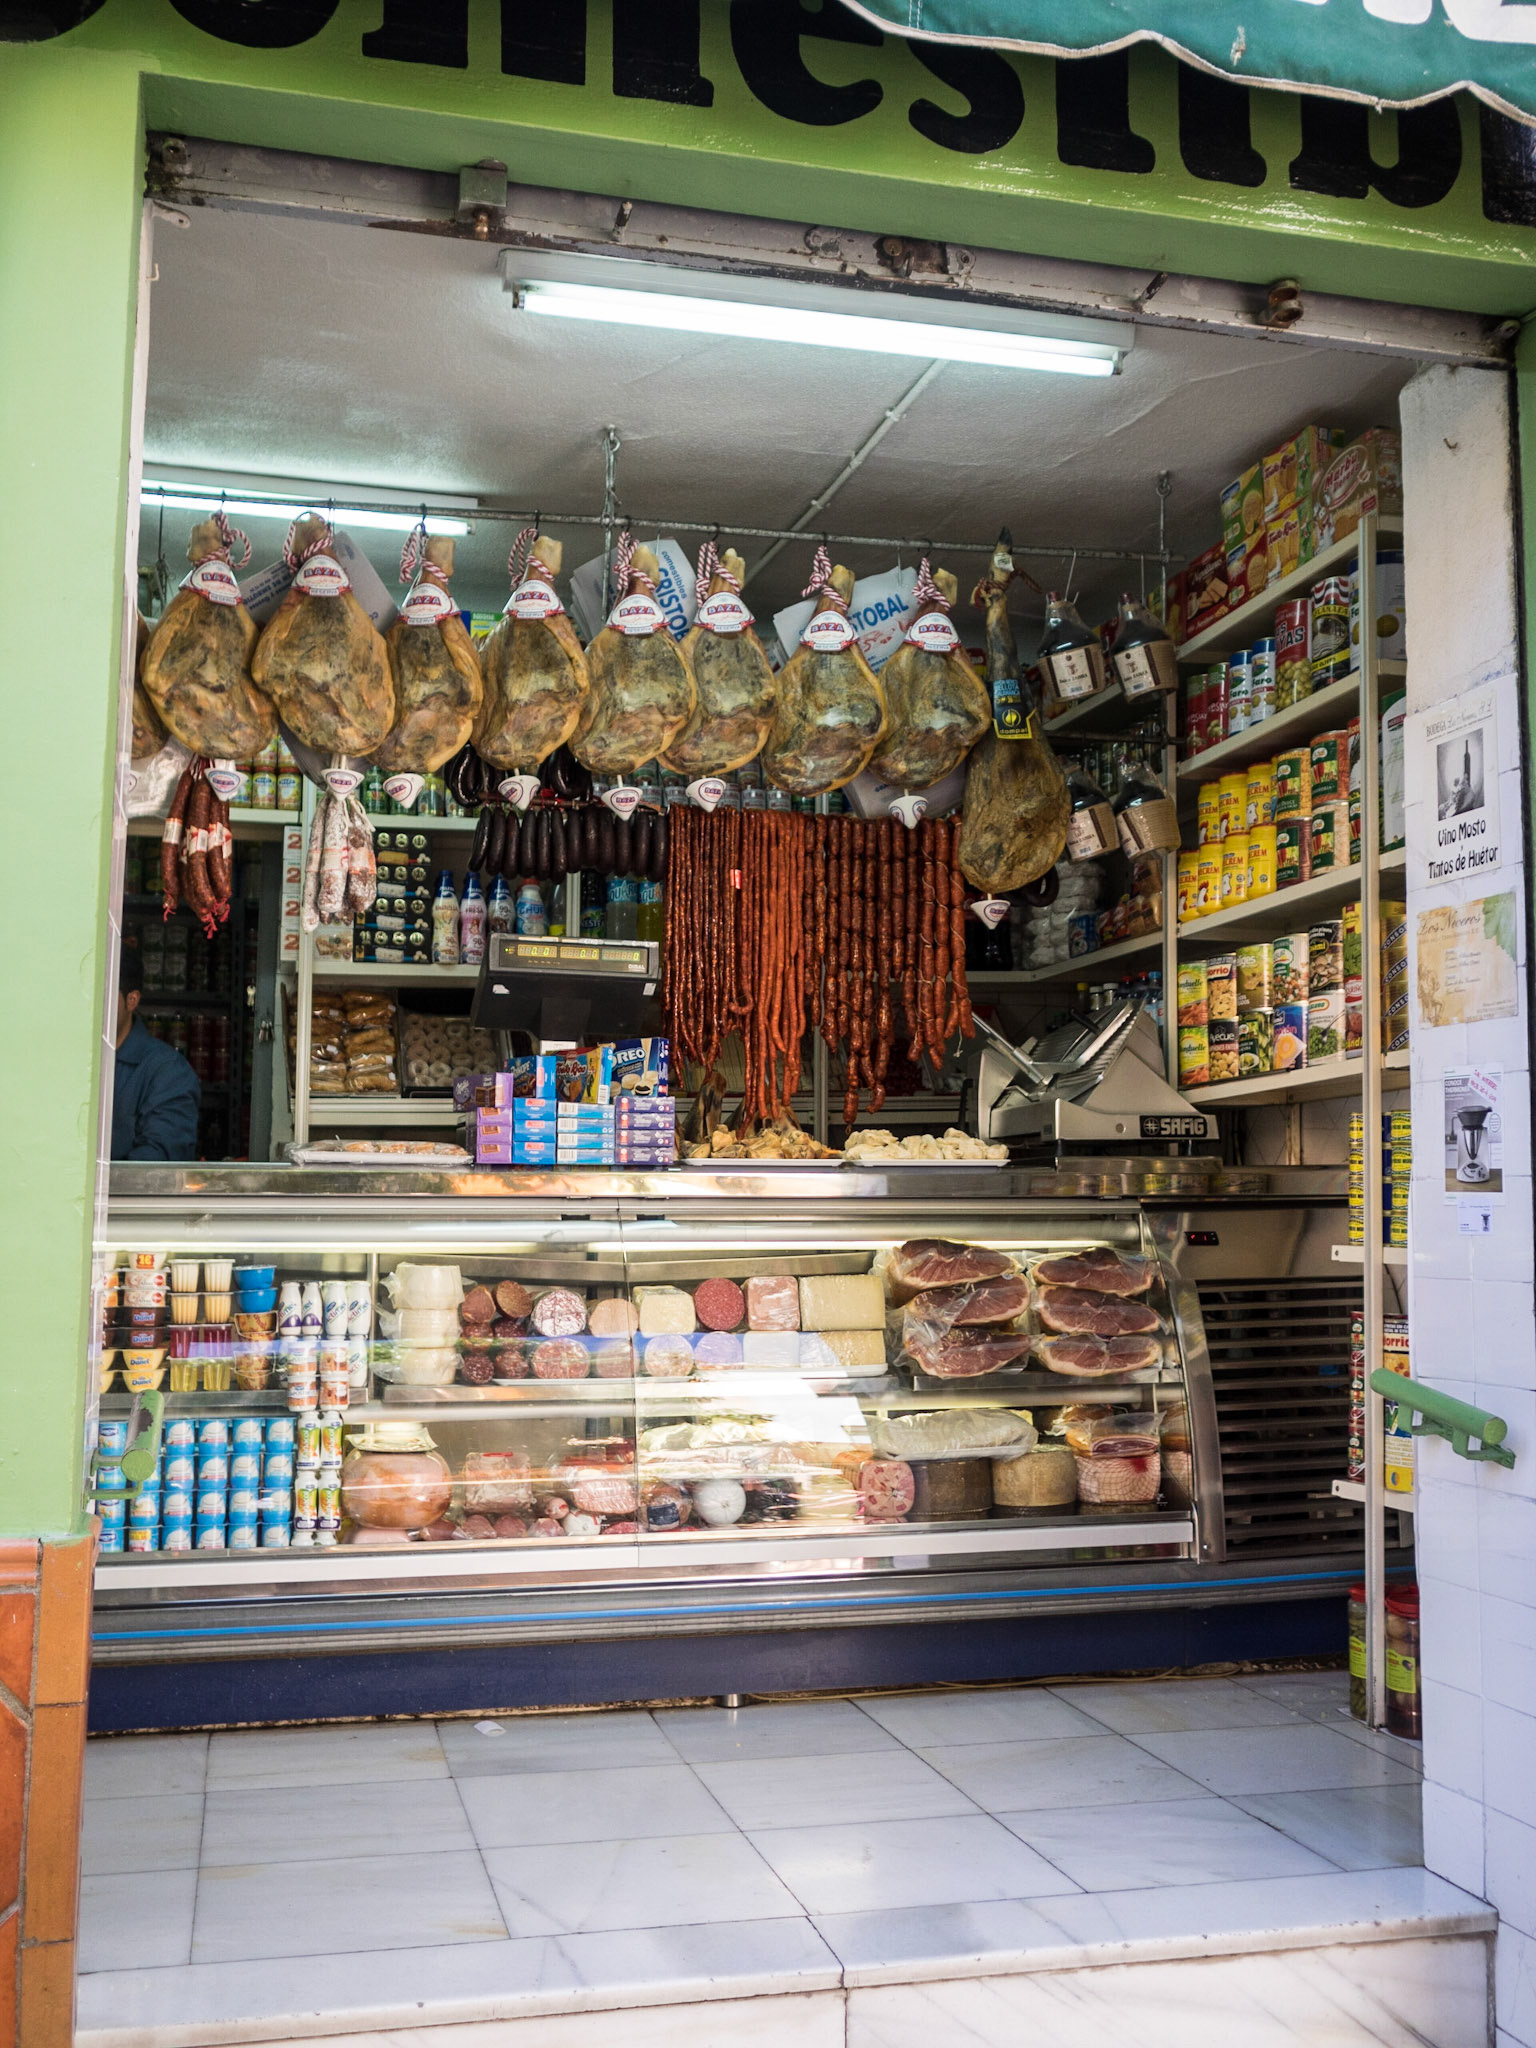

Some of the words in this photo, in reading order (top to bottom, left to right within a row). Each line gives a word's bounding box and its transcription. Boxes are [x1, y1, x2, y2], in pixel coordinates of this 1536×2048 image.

[303, 566, 342, 579] BAZA
[661, 550, 688, 600] comestibles
[406, 595, 441, 607] BAZA
[515, 591, 551, 602] BAZA
[619, 605, 656, 617] BAZA
[707, 603, 743, 615] BAZA
[810, 622, 845, 634] BAZA
[918, 623, 952, 635] BAZA
[1438, 828, 1457, 848] Vino
[1458, 819, 1487, 842] Mosto
[1428, 859, 1454, 880] Tintos
[1455, 852, 1466, 871] de
[1468, 845, 1499, 869] Huétor
[1160, 1117, 1205, 1136] SAFIG
